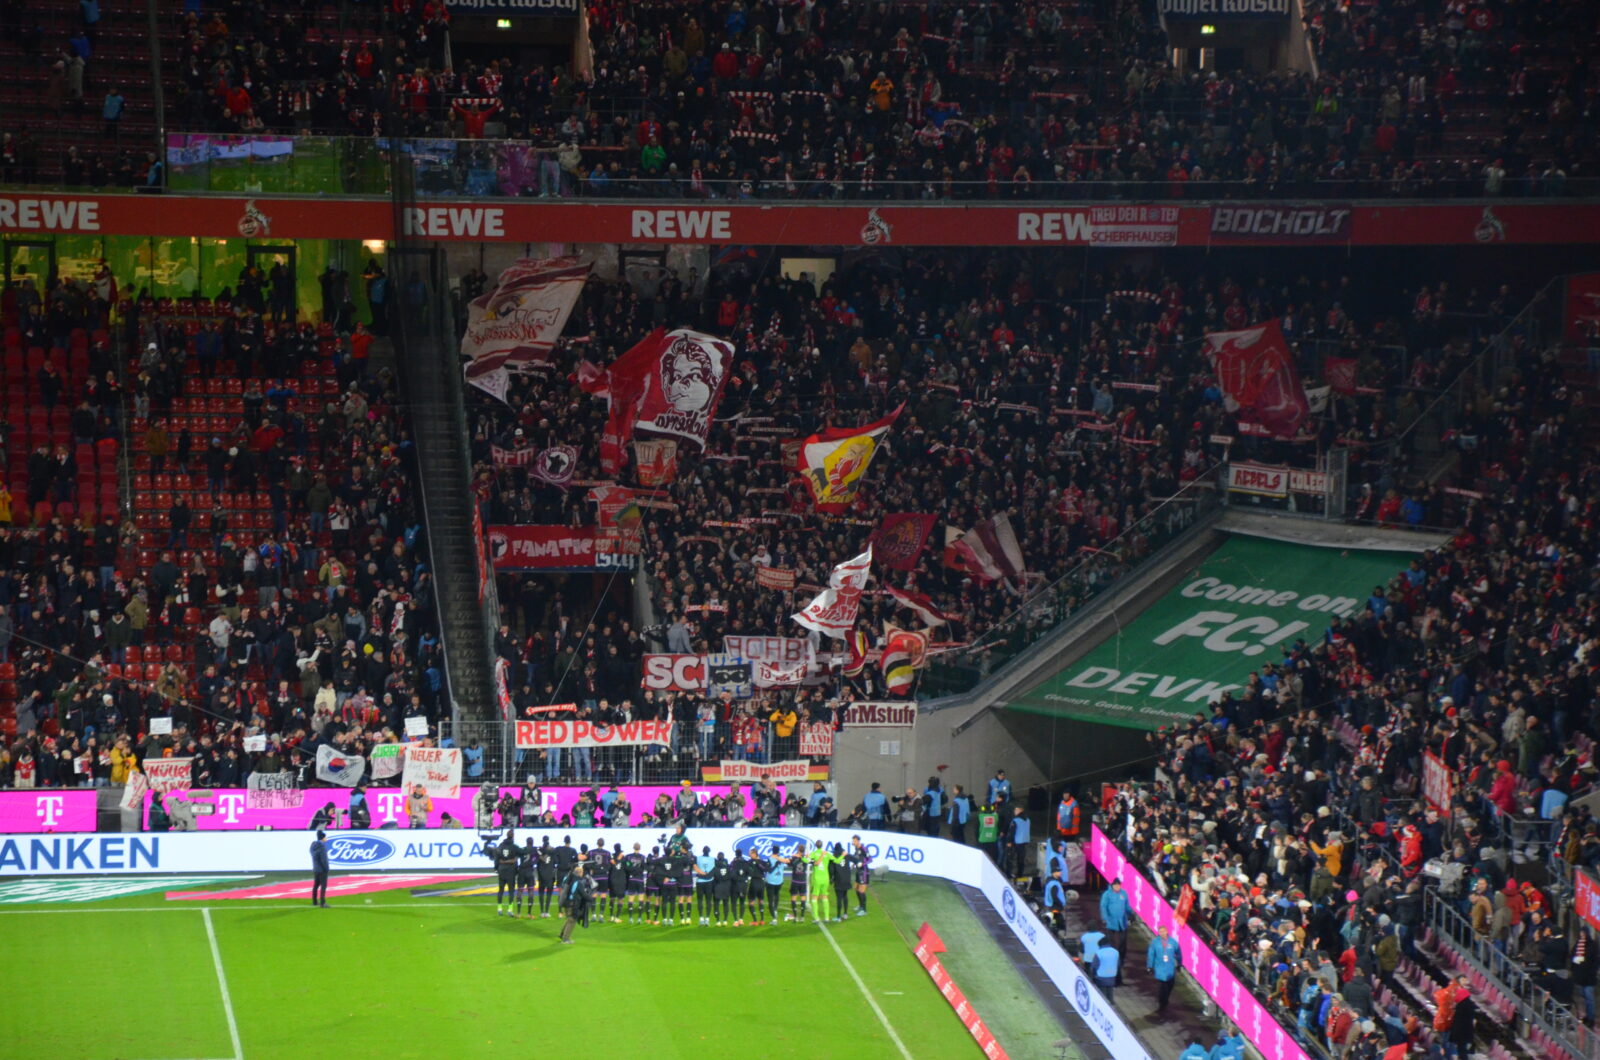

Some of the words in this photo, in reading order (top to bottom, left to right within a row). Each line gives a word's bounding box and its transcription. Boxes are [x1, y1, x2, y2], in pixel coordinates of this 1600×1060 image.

[0, 199, 101, 230] REWE
[403, 207, 505, 237] REWE
[631, 209, 732, 239] REWE
[1017, 212, 1091, 241] REW
[1091, 207, 1116, 222] TREU
[1119, 207, 1138, 222] DEN
[1211, 207, 1352, 235] BOCHOLT
[1234, 469, 1281, 489] REBELS
[1180, 576, 1299, 607] Come
[1152, 610, 1311, 657] FC!
[726, 636, 810, 661] ACAB!
[516, 721, 568, 745] RED
[572, 720, 673, 744] POWER
[410, 749, 443, 764] NEUER
[448, 750, 458, 764] 1
[723, 764, 747, 777] RED
[0, 836, 159, 870] ANKEN
[327, 838, 380, 861] Ford
[404, 842, 464, 858] AUTO
[884, 845, 925, 864] ABO
